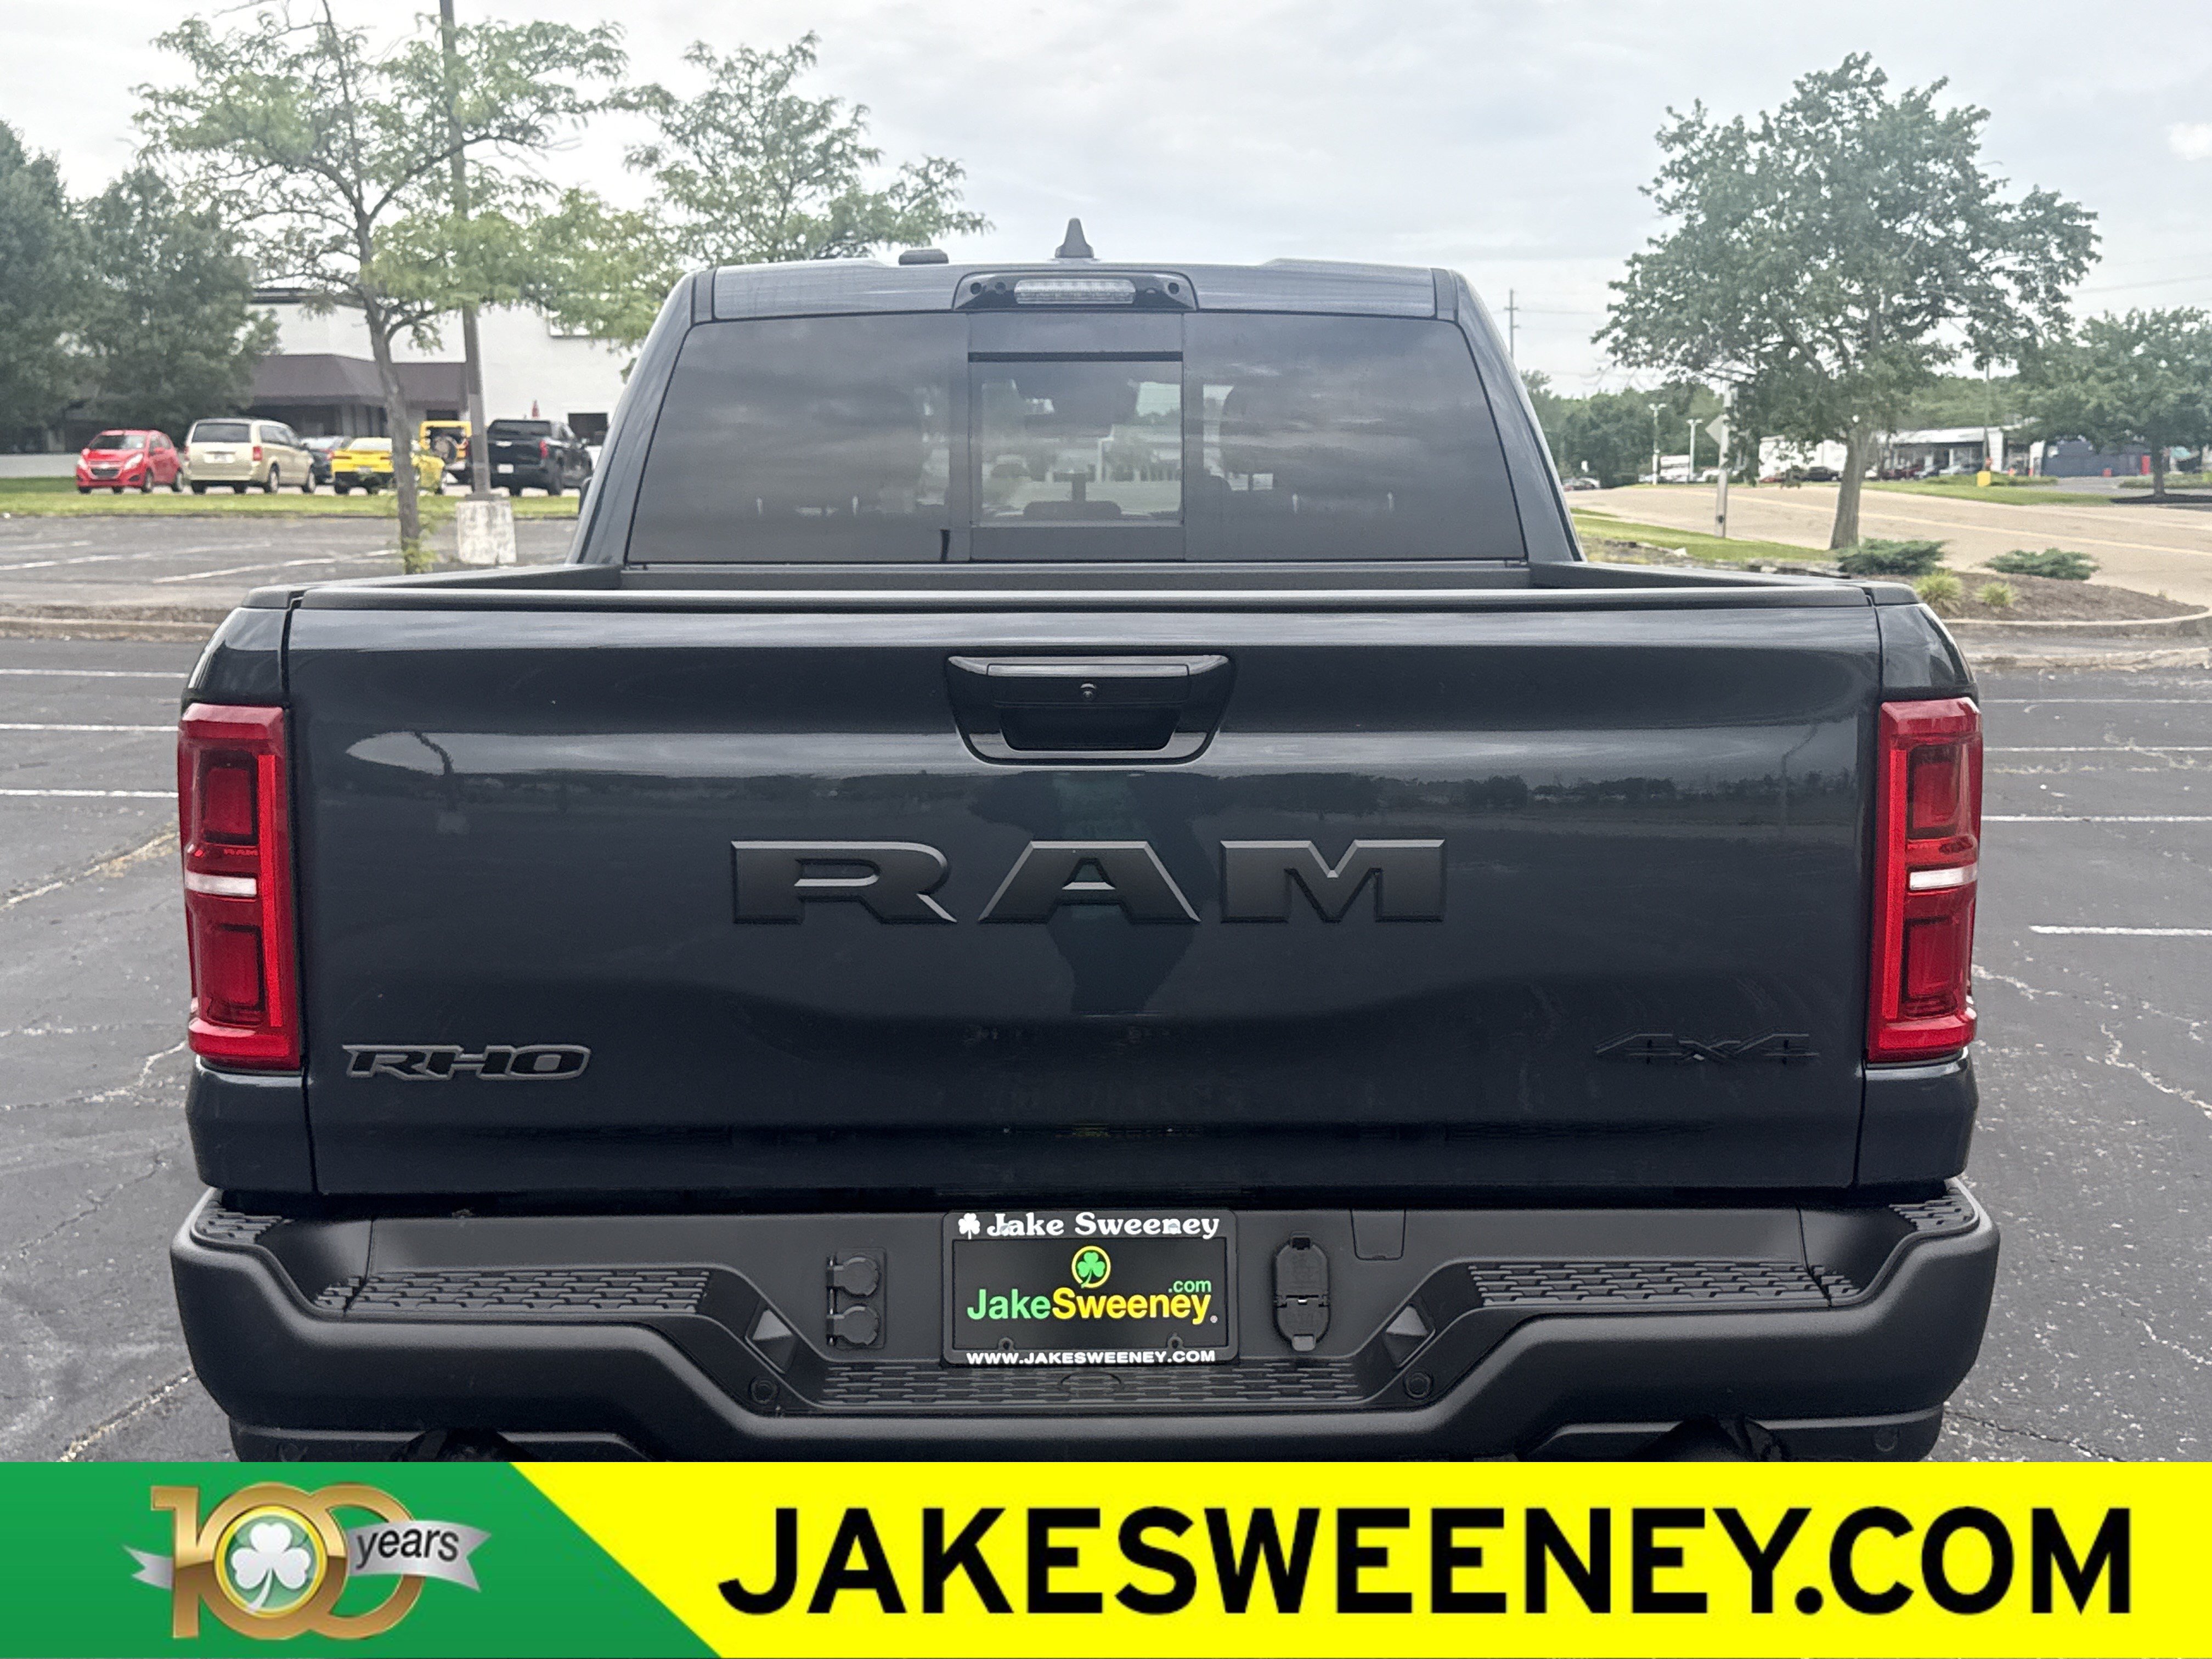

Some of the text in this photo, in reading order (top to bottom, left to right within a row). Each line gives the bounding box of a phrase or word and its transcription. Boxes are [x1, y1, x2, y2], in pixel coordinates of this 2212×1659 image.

[731, 839, 1447, 925] RAM
[342, 1044, 592, 1081] RHO
[986, 1211, 1220, 1239] Jake Sweeney
[966, 1349, 1216, 1365] WWW.JAKESWEENEY.COM
